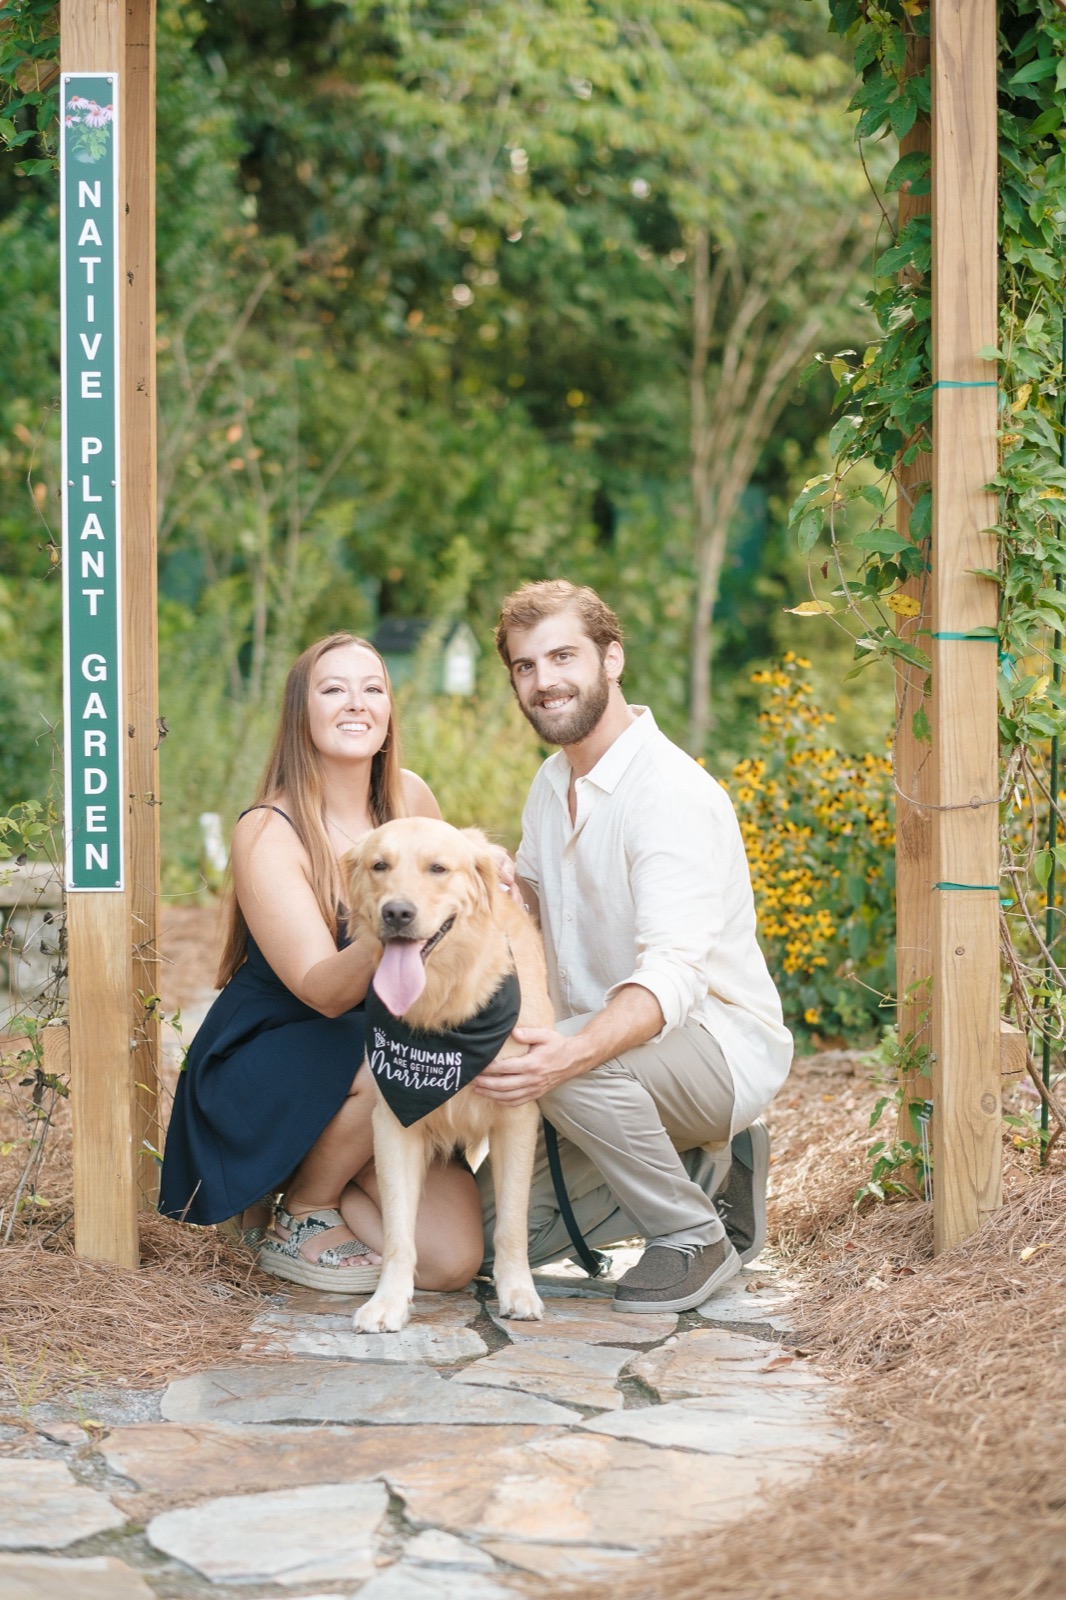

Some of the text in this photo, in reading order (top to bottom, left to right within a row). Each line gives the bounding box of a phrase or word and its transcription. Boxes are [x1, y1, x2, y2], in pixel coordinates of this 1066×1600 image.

[77, 180, 108, 870] NATIVE PLANT GARDEN
[390, 1040, 462, 1066] MY HUMANS
[393, 1057, 444, 1075] ARE GETTING
[371, 1050, 462, 1091] Married!
